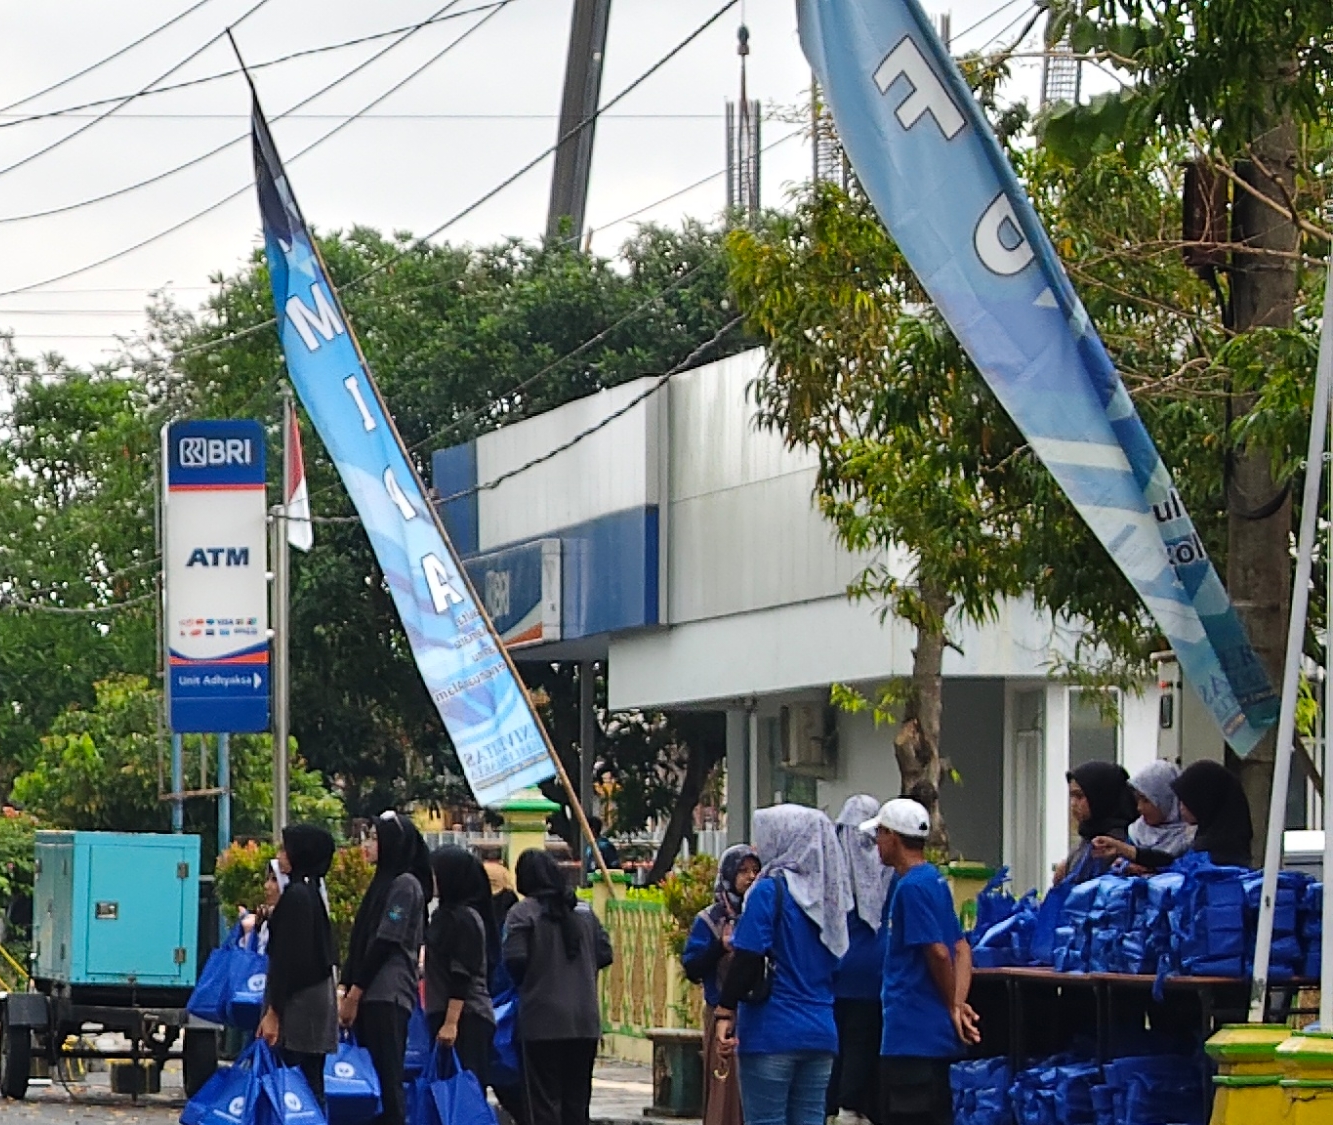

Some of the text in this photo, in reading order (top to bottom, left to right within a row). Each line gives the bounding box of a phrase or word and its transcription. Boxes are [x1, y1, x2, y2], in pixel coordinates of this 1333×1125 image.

[208, 438, 252, 466] BRI
[186, 547, 250, 567] ATM
[178, 675, 201, 686] Unit
